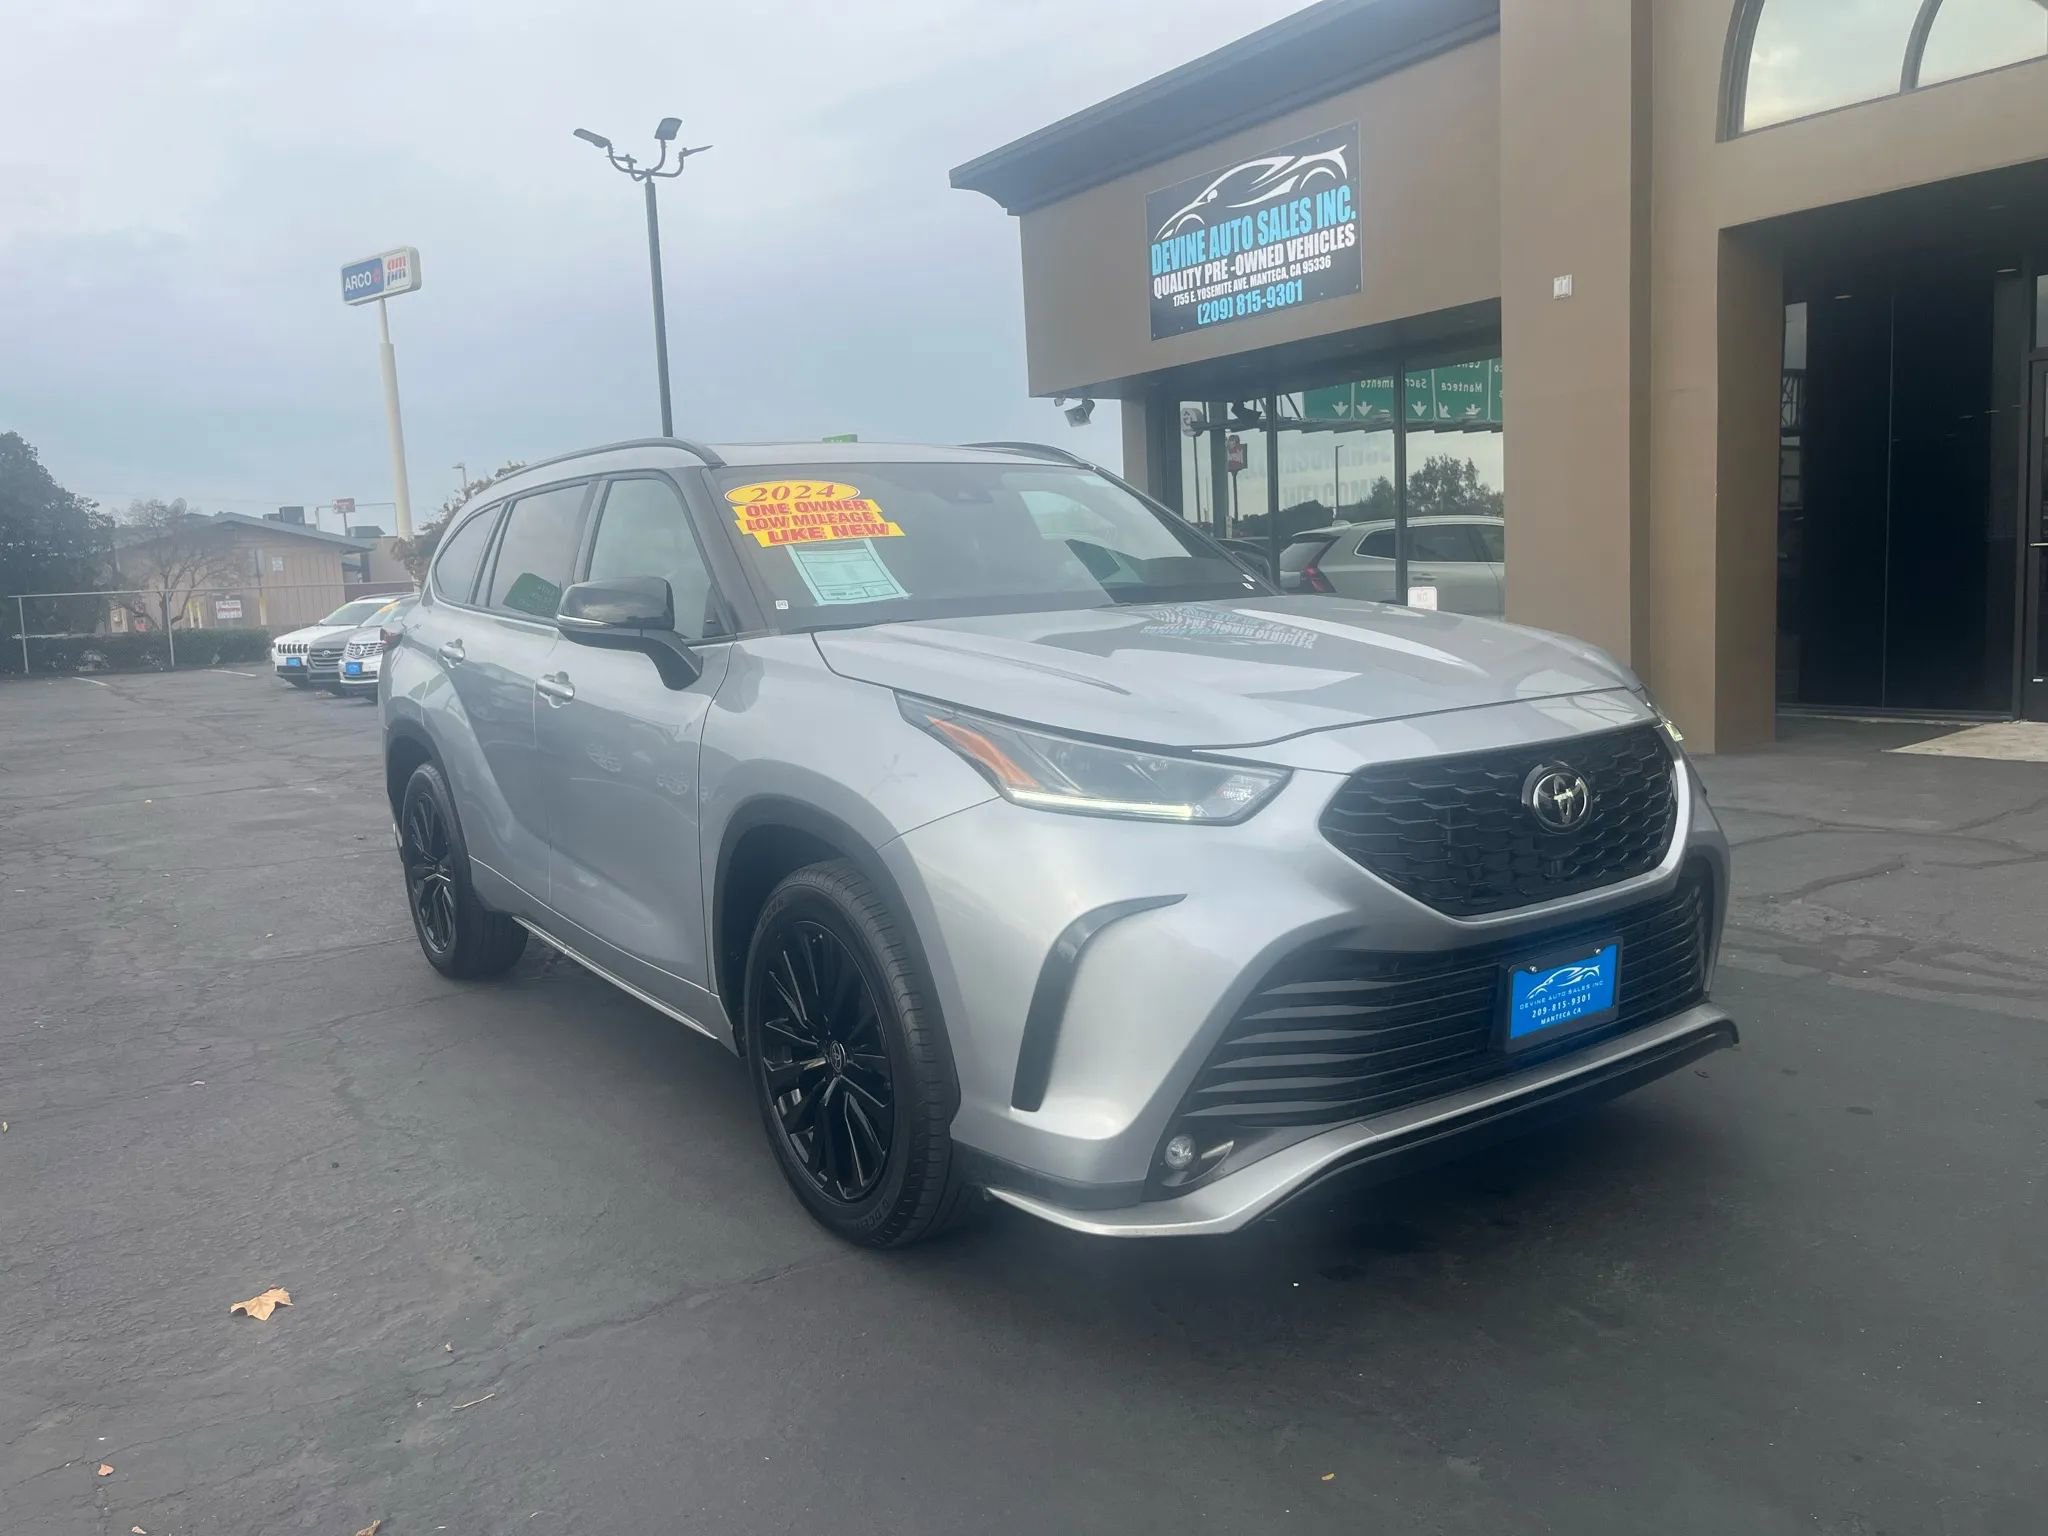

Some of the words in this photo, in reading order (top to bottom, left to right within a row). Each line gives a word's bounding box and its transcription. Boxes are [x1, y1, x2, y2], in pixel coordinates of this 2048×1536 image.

[1151, 229, 1206, 276] DEVINE
[1209, 215, 1253, 260] AUTO
[1257, 197, 1312, 246] SALES
[1316, 185, 1356, 229] INC.
[1153, 265, 1202, 299] QUALITY
[1204, 258, 1229, 284] PRE
[1286, 223, 1355, 262] VEHICLES
[344, 271, 372, 292] ARCO
[1173, 292, 1190, 307] 1755
[1190, 290, 1197, 303] E.
[1196, 281, 1232, 301] YOSEMITE
[1233, 277, 1249, 292] AVE.
[1249, 266, 1288, 288] MANTECA,
[1289, 262, 1302, 277] CA
[1302, 255, 1331, 274] 95336
[1197, 297, 1234, 325] (209)
[1236, 279, 1303, 316] 815-9301
[750, 484, 835, 502] 2024
[745, 503, 791, 517] ONE
[794, 500, 870, 513] OWNER
[745, 517, 790, 531] LOW
[791, 511, 876, 527] MILEAGE
[767, 526, 827, 544] LIKE
[831, 523, 890, 538] NEW
[1519, 997, 1546, 1010] DEVINE
[1548, 990, 1566, 1001] AUTO
[1567, 983, 1590, 995] SALES
[1591, 980, 1604, 989] INC
[1540, 1010, 1571, 1025] MANTECA
[1572, 1007, 1582, 1015] CA
